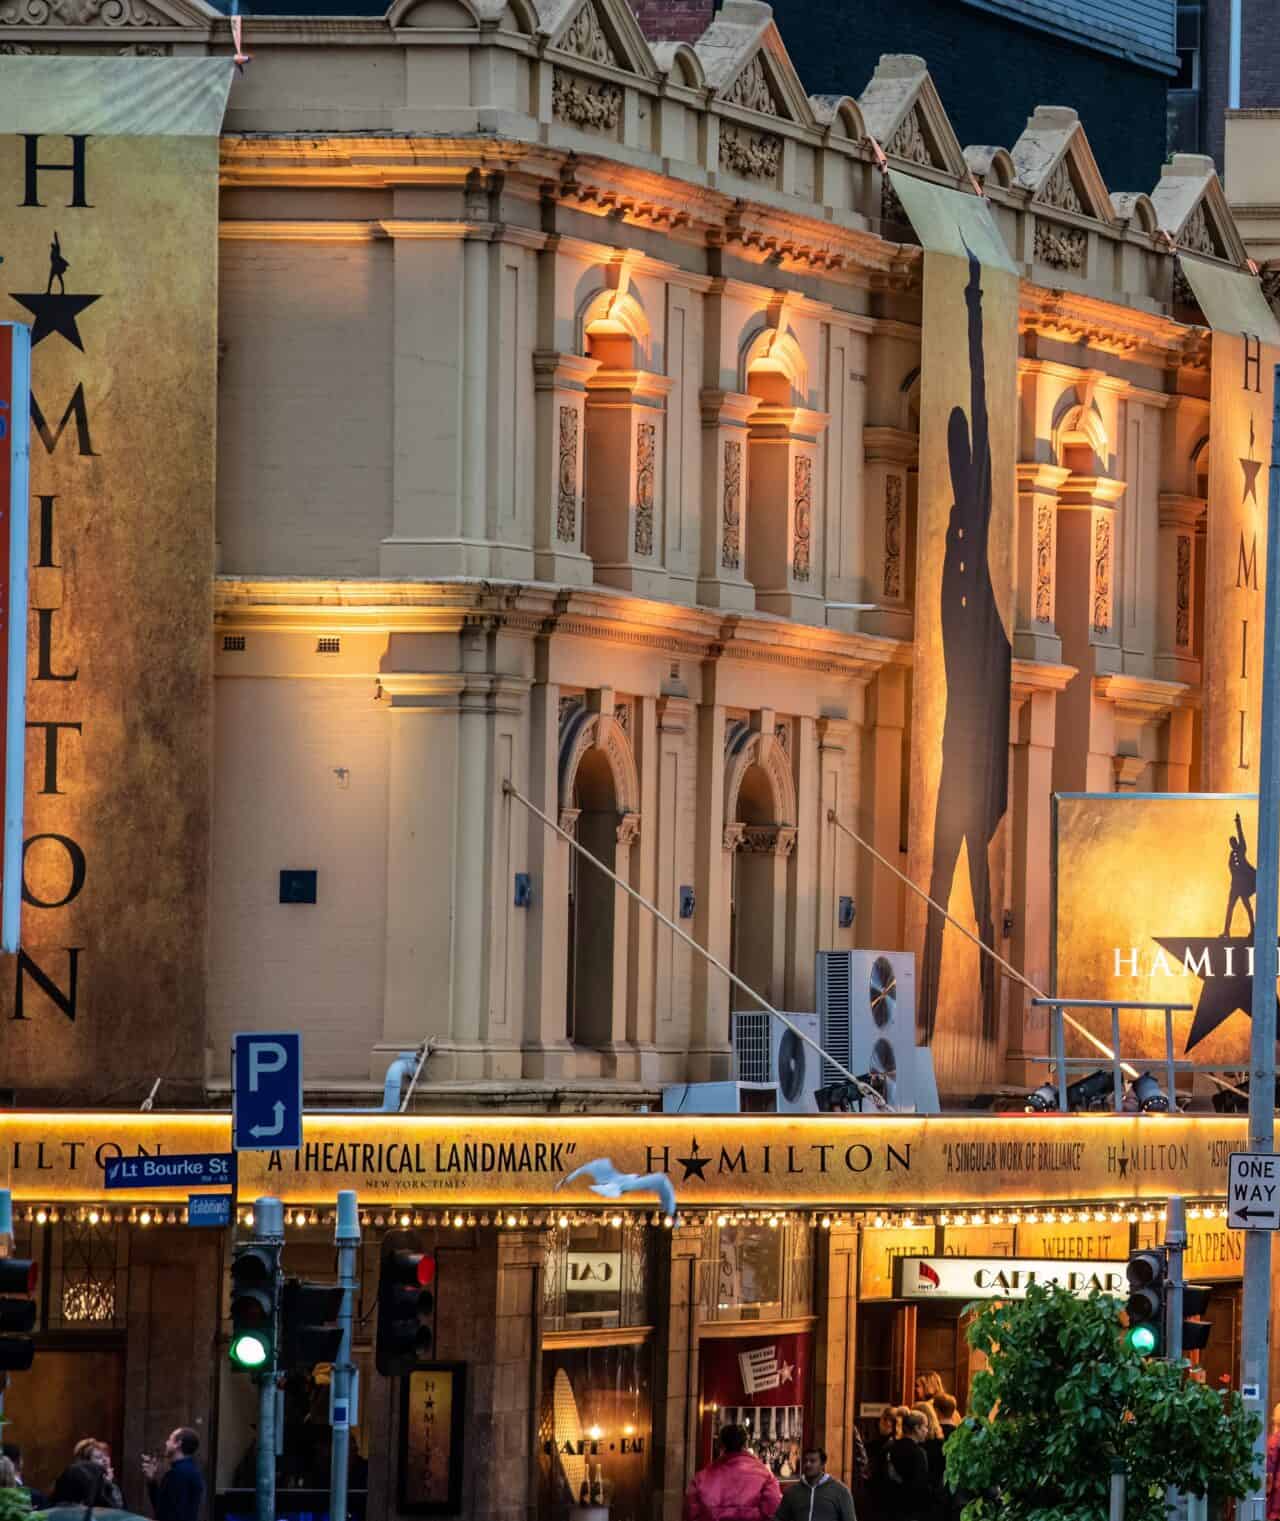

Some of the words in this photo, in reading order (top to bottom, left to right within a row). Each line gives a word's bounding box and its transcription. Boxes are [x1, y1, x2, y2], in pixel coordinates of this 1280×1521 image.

[249, 1042, 288, 1092] P
[122, 1163, 139, 1177] Lt
[144, 1160, 204, 1176] Bourke
[209, 1158, 229, 1173] St
[1238, 1161, 1276, 1179] ONE
[366, 1180, 390, 1189] NEW
[395, 1180, 425, 1189] YORK
[433, 1180, 467, 1189] TIMES
[1234, 1185, 1276, 1201] WAY
[1068, 1271, 1124, 1293] BAR
